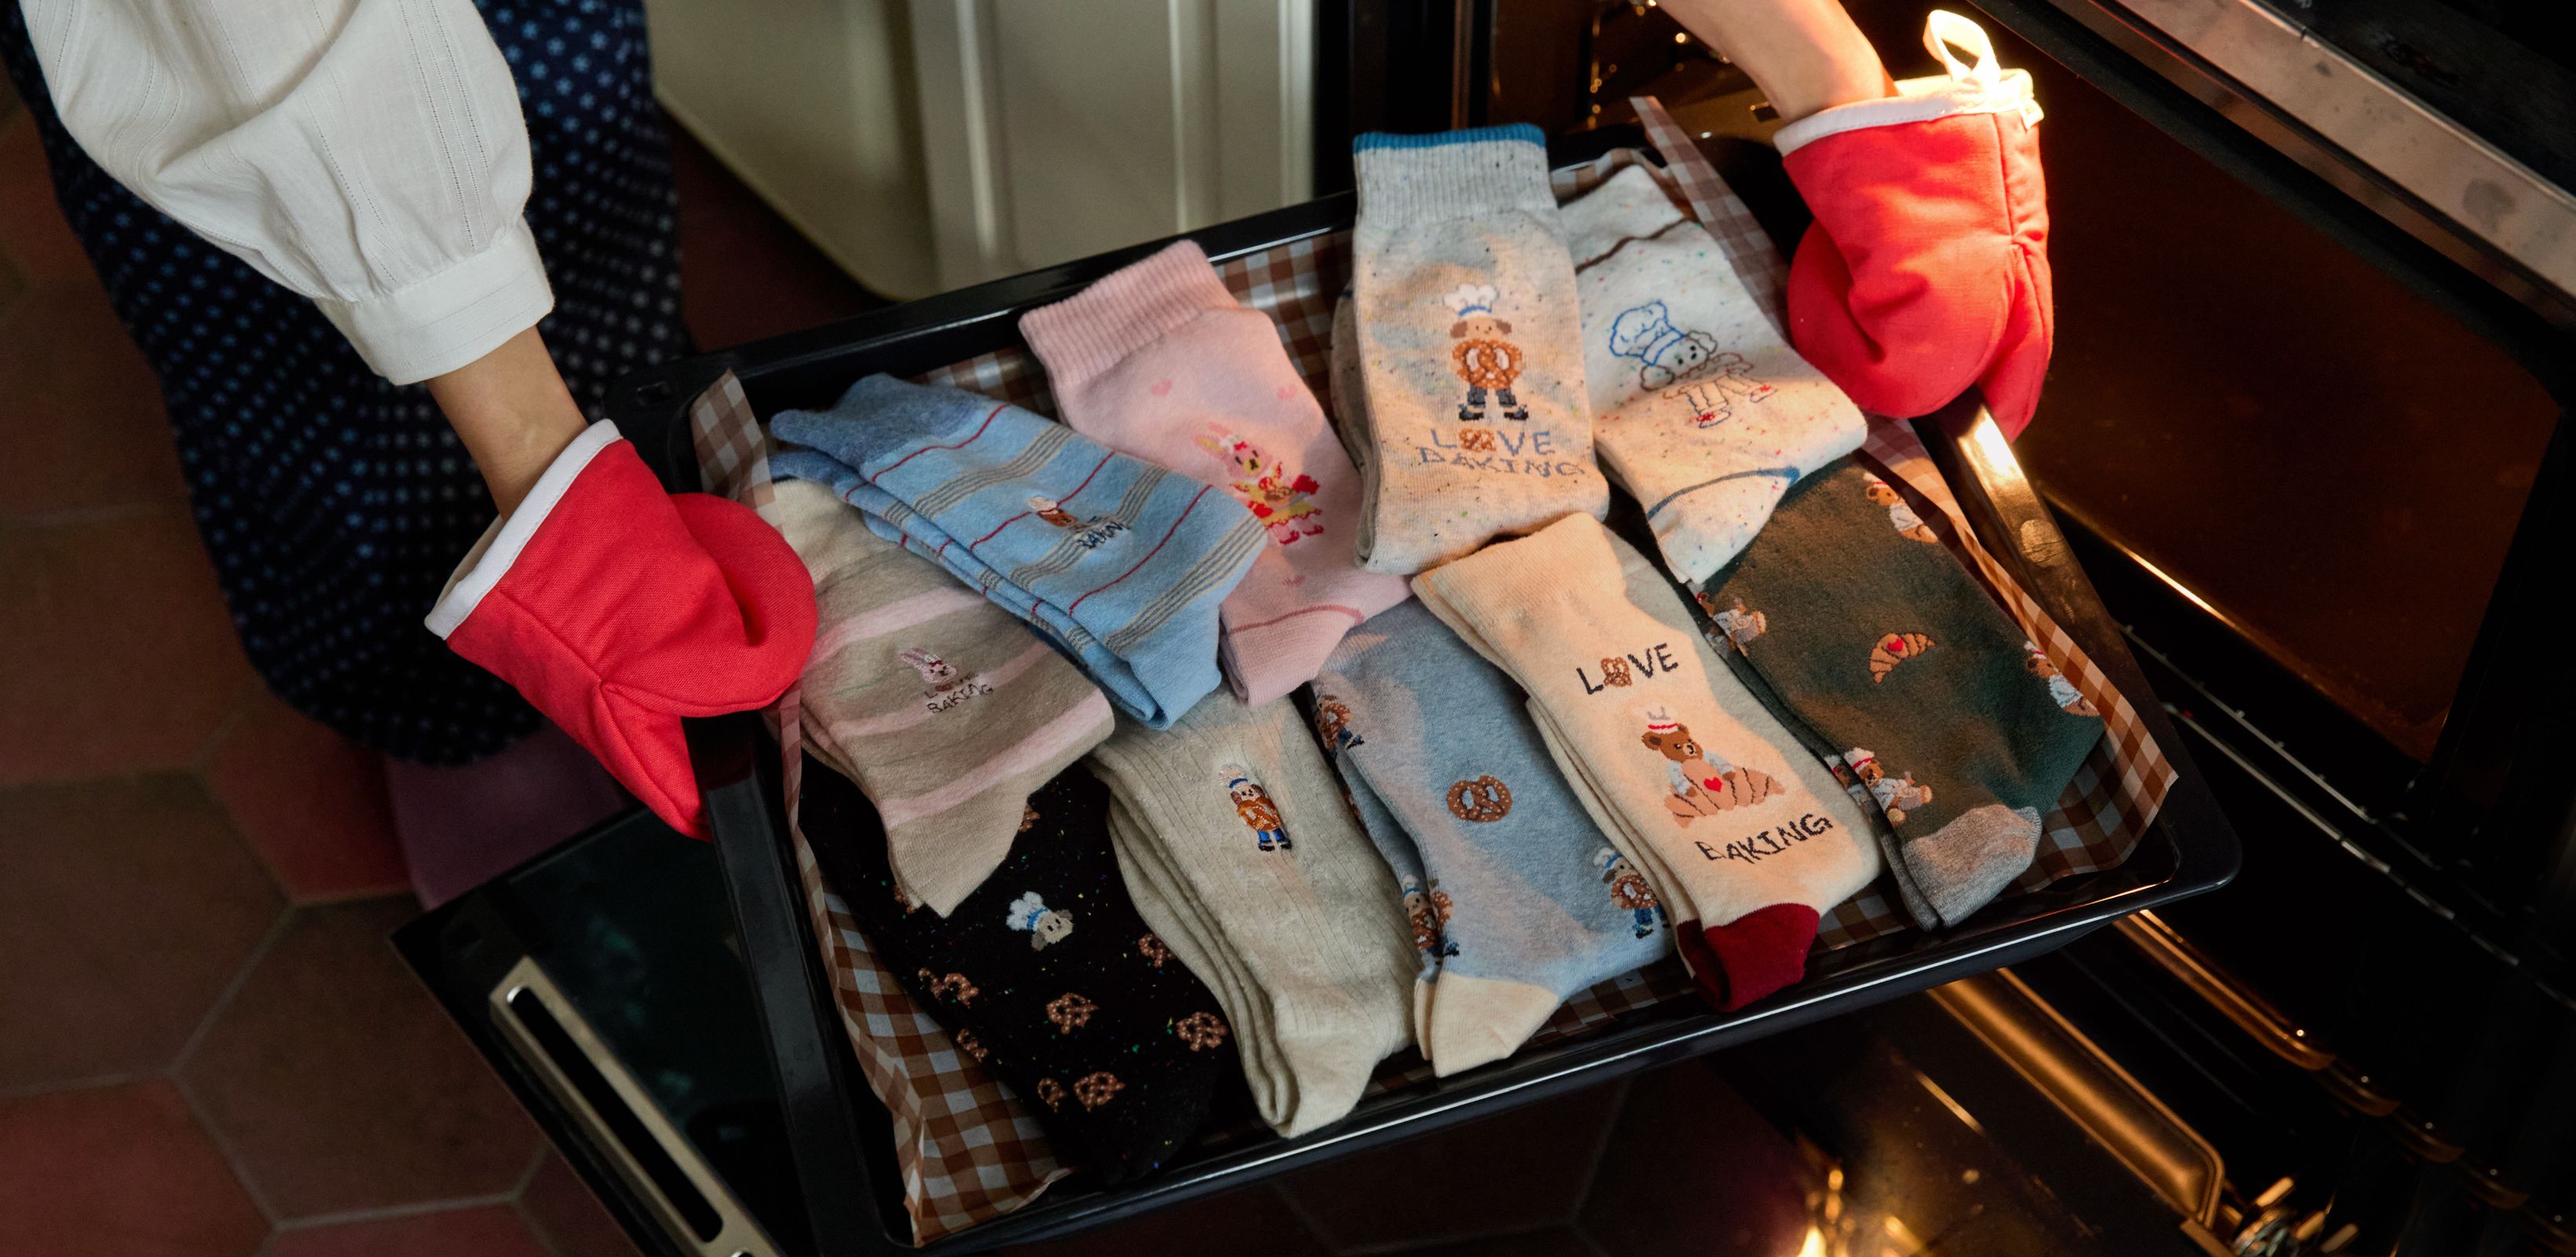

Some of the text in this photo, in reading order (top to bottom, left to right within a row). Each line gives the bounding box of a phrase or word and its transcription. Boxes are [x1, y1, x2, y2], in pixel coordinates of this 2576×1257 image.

[1429, 427, 1556, 457] LOVE
[1575, 642, 1679, 695] LOVE
[1694, 813, 1834, 865] BAKING
